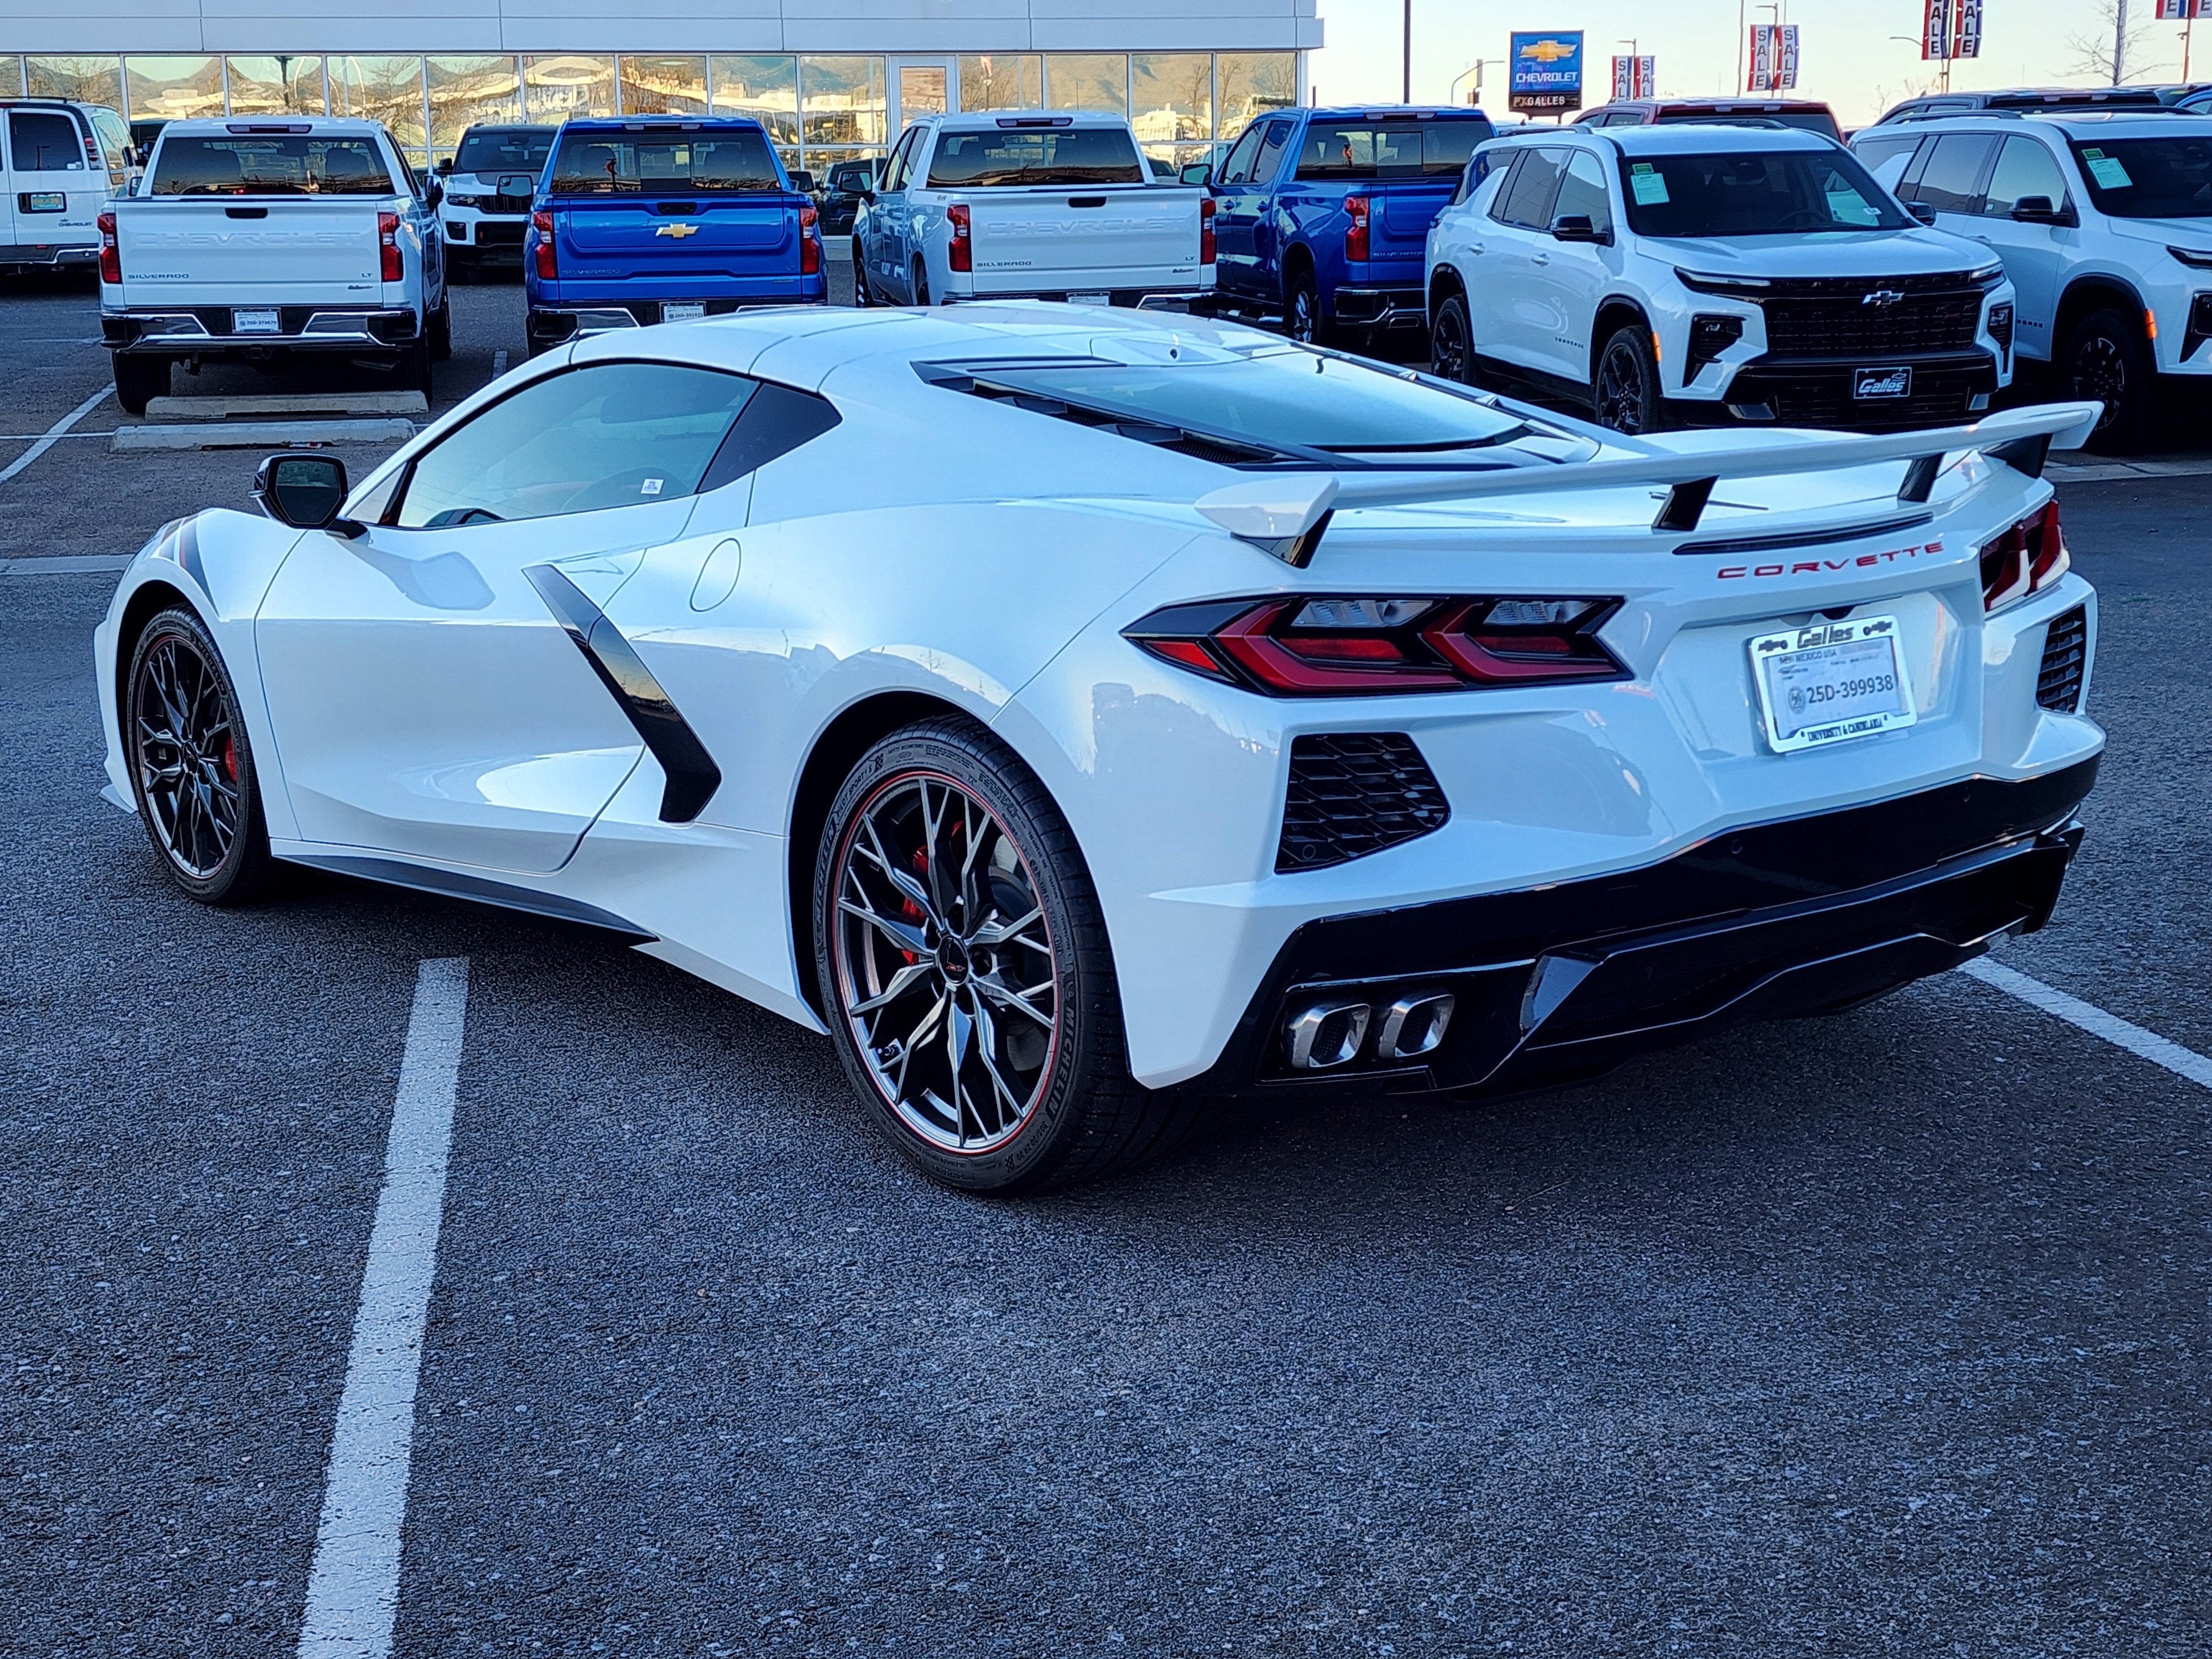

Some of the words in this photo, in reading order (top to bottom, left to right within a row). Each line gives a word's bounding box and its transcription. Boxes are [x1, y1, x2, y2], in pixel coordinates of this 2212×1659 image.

[1931, 0, 1941, 54] ALE
[1962, 0, 1975, 53] ALE
[1756, 30, 1767, 86] SALE
[1782, 29, 1794, 85] SALE
[1516, 72, 1578, 82] CHEVROLET
[1618, 60, 1626, 98] SAL
[1527, 96, 1565, 106] GALLES
[137, 233, 360, 246] CHEVROLET
[987, 218, 1187, 236] CHEVROLET
[1858, 378, 1906, 393] Galles
[1718, 541, 1944, 579] CORVETTE
[1797, 626, 1854, 649] Galles
[1796, 651, 1822, 662] MEXICO
[1824, 649, 1837, 658] USA
[1807, 675, 1893, 704] 25D-399938
[1049, 1005, 1074, 1115] MICHELIN
